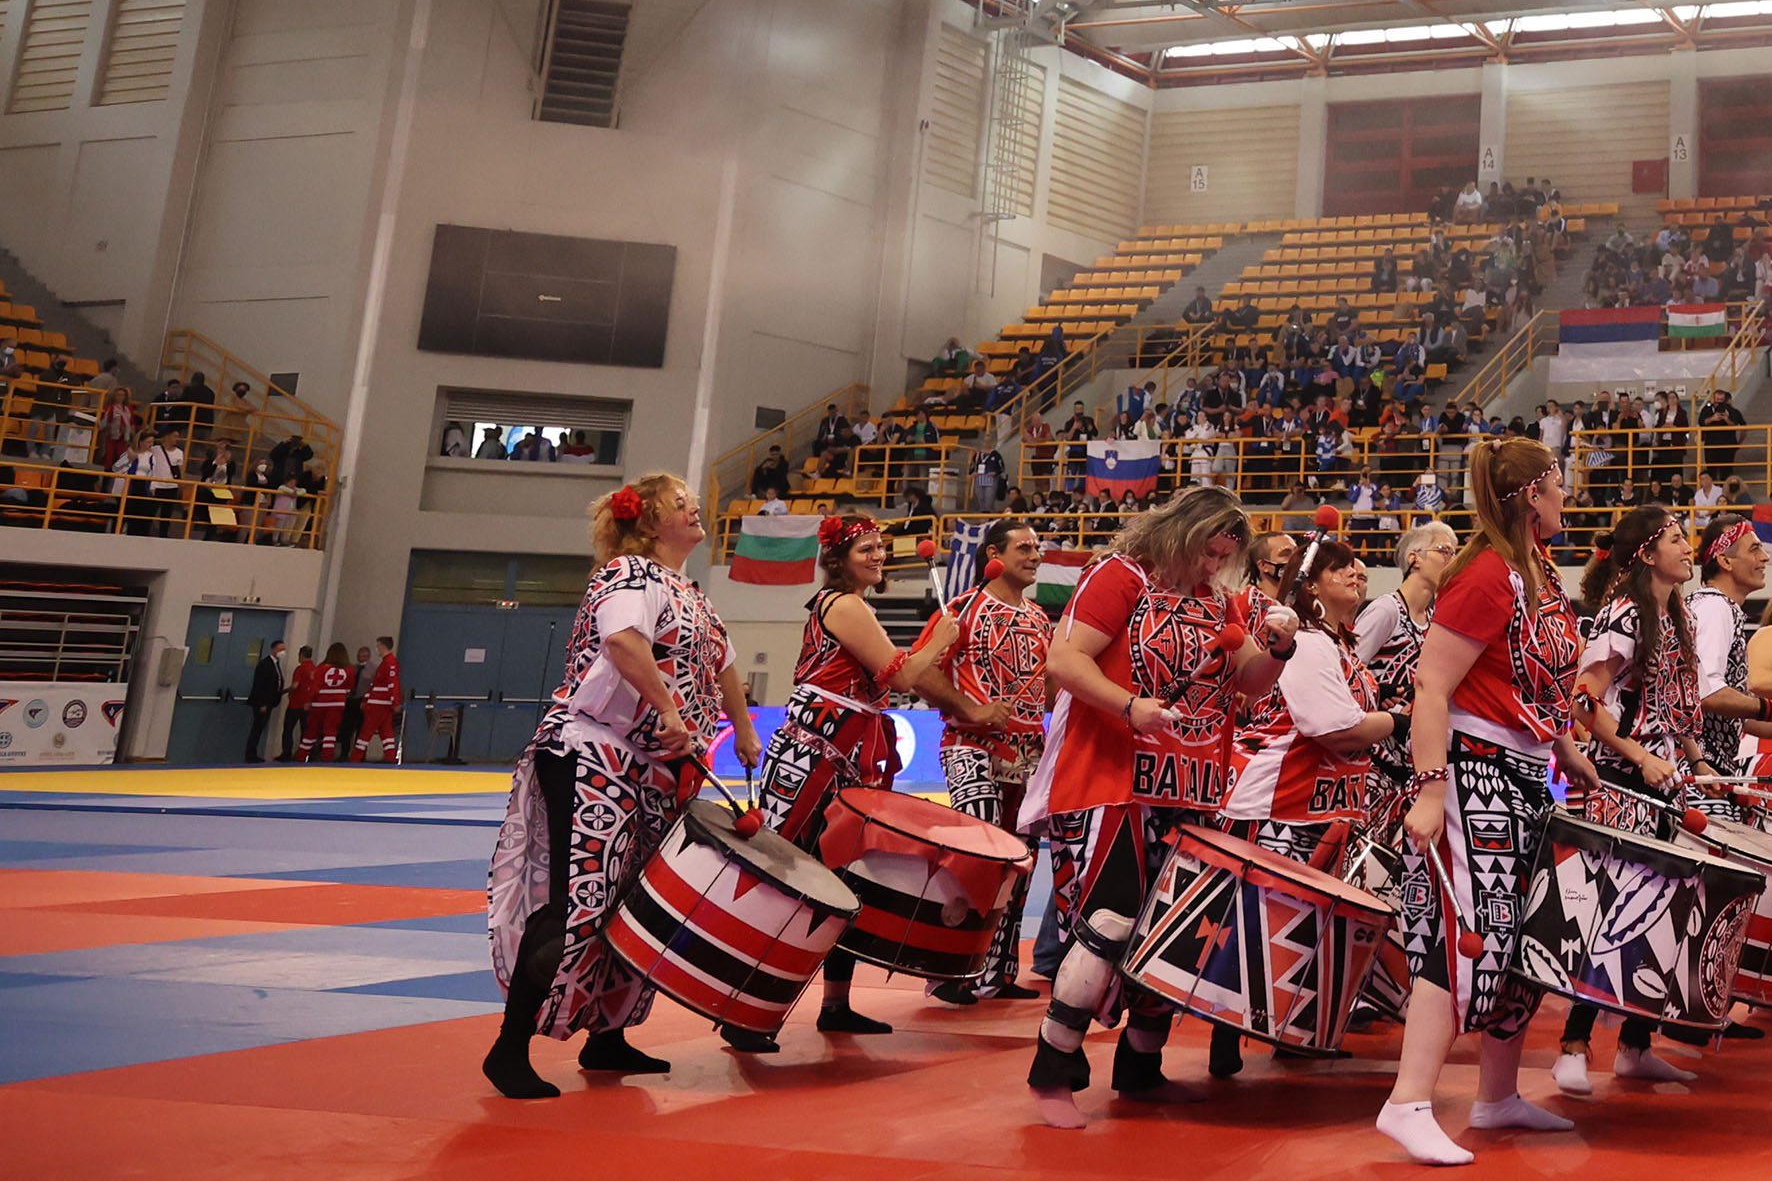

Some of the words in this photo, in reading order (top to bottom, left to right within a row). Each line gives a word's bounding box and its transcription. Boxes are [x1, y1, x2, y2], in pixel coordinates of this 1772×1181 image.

[1673, 149, 1687, 160] 13
[1482, 159, 1494, 169] 14
[1193, 179, 1205, 190] 15
